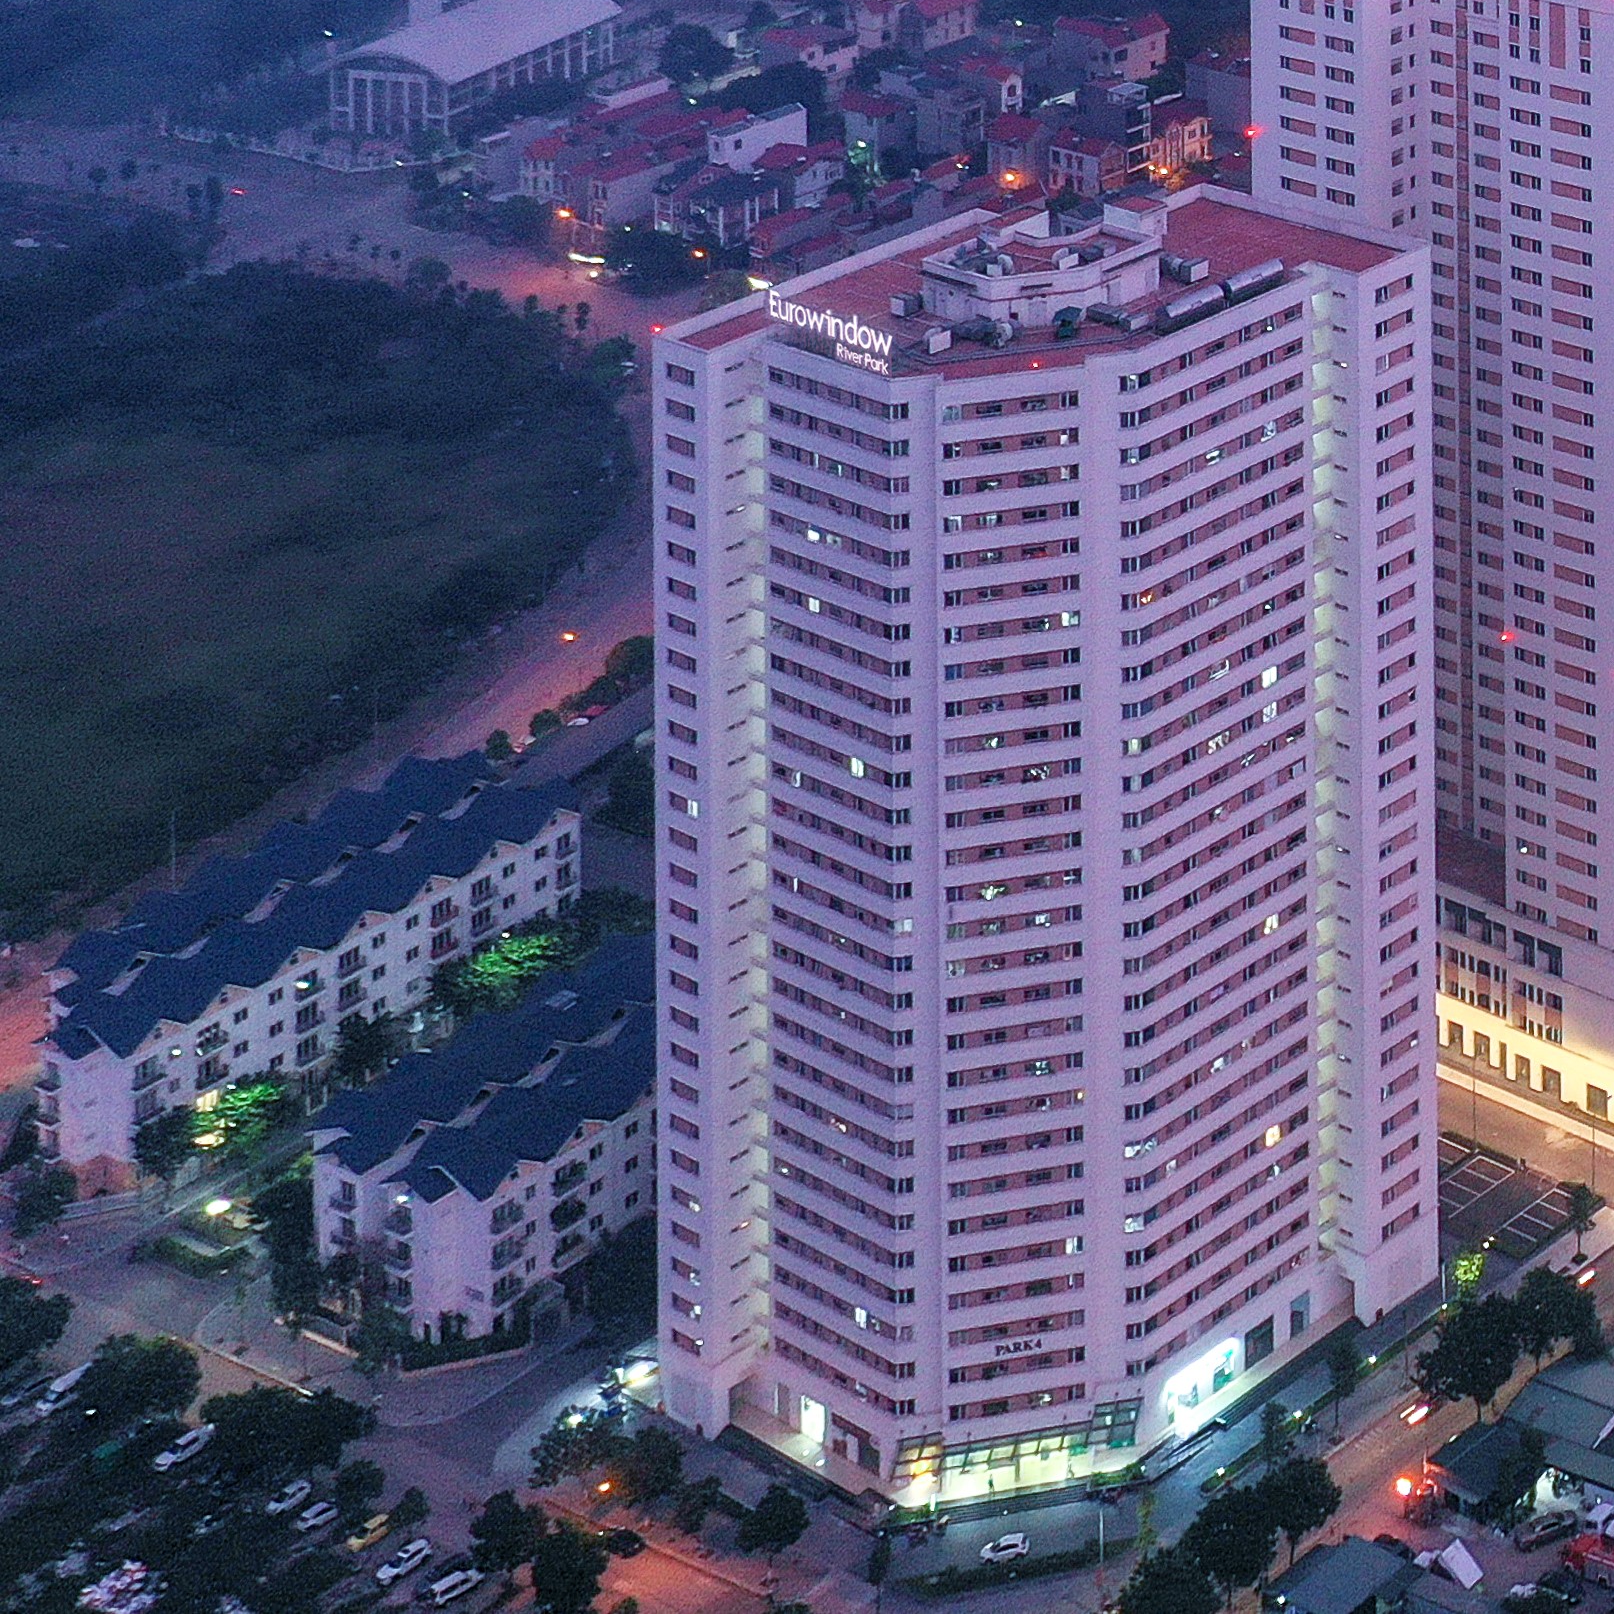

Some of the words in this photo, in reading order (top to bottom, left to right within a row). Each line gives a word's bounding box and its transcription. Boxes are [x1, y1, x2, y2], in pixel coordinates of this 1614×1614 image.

[769, 289, 893, 356] Eurowindow
[836, 343, 863, 365] River
[864, 353, 889, 375] Park
